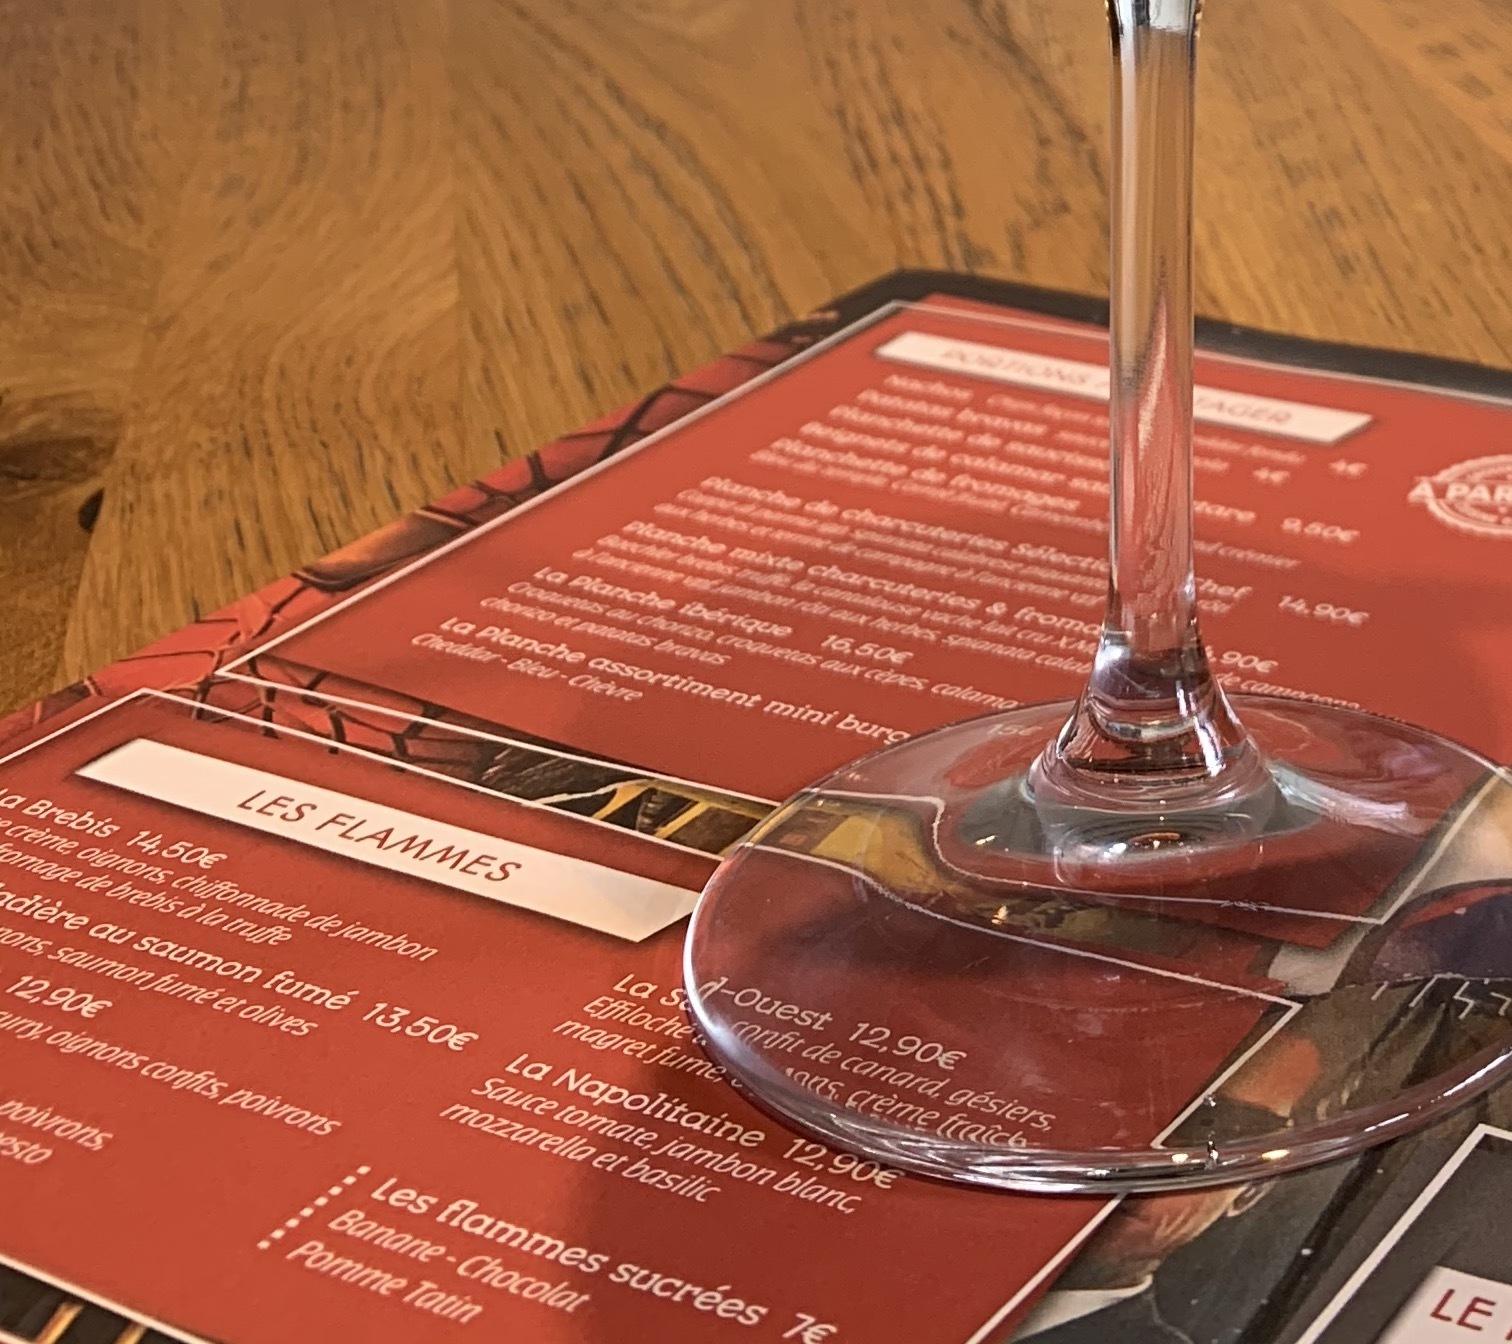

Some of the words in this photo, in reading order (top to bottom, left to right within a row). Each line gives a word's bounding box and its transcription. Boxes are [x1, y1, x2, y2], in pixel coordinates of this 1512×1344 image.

[623, 521, 726, 553] Planche
[729, 547, 804, 570] mixte
[808, 565, 981, 609] charcuteries
[986, 602, 1007, 615] &
[701, 477, 801, 508] Planche
[804, 500, 838, 515] de
[841, 509, 1008, 551] charcuteries
[1278, 595, 1370, 626] 14,90€
[533, 566, 568, 585] La
[568, 574, 677, 611] Planche
[679, 602, 793, 638] ibérique
[820, 634, 914, 665] 16,50€
[553, 614, 581, 629] et
[571, 619, 658, 648] patatas
[653, 639, 733, 666] bravas
[716, 633, 823, 667] croquetas
[820, 657, 867, 677] aux
[411, 632, 502, 662] Cheddar
[507, 657, 560, 679] Bleu
[568, 673, 644, 701] Chèvre
[440, 616, 477, 635] La
[475, 625, 587, 664] Planche
[588, 657, 763, 708] assortiment
[763, 698, 840, 726] mini
[22, 799, 121, 838] Brebis
[126, 830, 229, 870] 14,50€
[237, 790, 318, 823] LES
[315, 812, 523, 883] FLAMMES
[0, 842, 84, 882] fromage
[75, 874, 114, 893] de
[105, 880, 185, 914] brebis
[176, 902, 208, 920] à
[196, 908, 230, 927] la
[221, 917, 293, 946] truffe
[4, 824, 80, 856] crème,
[76, 846, 175, 885] oignons,
[171, 875, 311, 924] chiffonnade
[304, 913, 344, 933] de
[328, 921, 440, 962] jambon
[6, 975, 113, 1019] 12,90€
[48, 946, 156, 992] saumon
[154, 973, 226, 1005] fumé
[211, 995, 248, 1013] et
[238, 1005, 319, 1036] olives
[88, 923, 137, 944] au
[132, 935, 263, 984] saumon
[262, 970, 361, 1010] fumé
[362, 1002, 480, 1052] 13,50€
[613, 973, 658, 999] La
[848, 1022, 967, 1071] 12,90€
[46, 1031, 150, 1070] oignons
[140, 1061, 229, 1100] confits,
[218, 1088, 342, 1136] poivrons
[552, 1019, 658, 1058] magret
[801, 1042, 843, 1065] de
[840, 1055, 941, 1099] canard,
[948, 1090, 1057, 1132] gésiers,
[439, 1103, 597, 1161] mozzarella
[592, 1151, 629, 1172] et
[621, 1157, 722, 1203] basilic
[471, 1078, 559, 1115] Sauce
[554, 1103, 659, 1151] tomate,
[650, 1136, 769, 1186] jambon
[773, 1171, 863, 1215] blanc,
[505, 1053, 553, 1081] La
[552, 1068, 766, 1148] Napolitaine
[783, 1138, 905, 1189] 12,90€
[285, 1239, 408, 1296] Pomme
[402, 1279, 483, 1324] Tatin
[327, 1208, 446, 1263] Banane
[456, 1254, 591, 1312] Chocolat
[371, 1177, 439, 1215] Les
[436, 1198, 610, 1273] flammes
[609, 1263, 768, 1328] sucrées
[781, 1312, 840, 1344] 7€
[1430, 1288, 1497, 1331] LE
